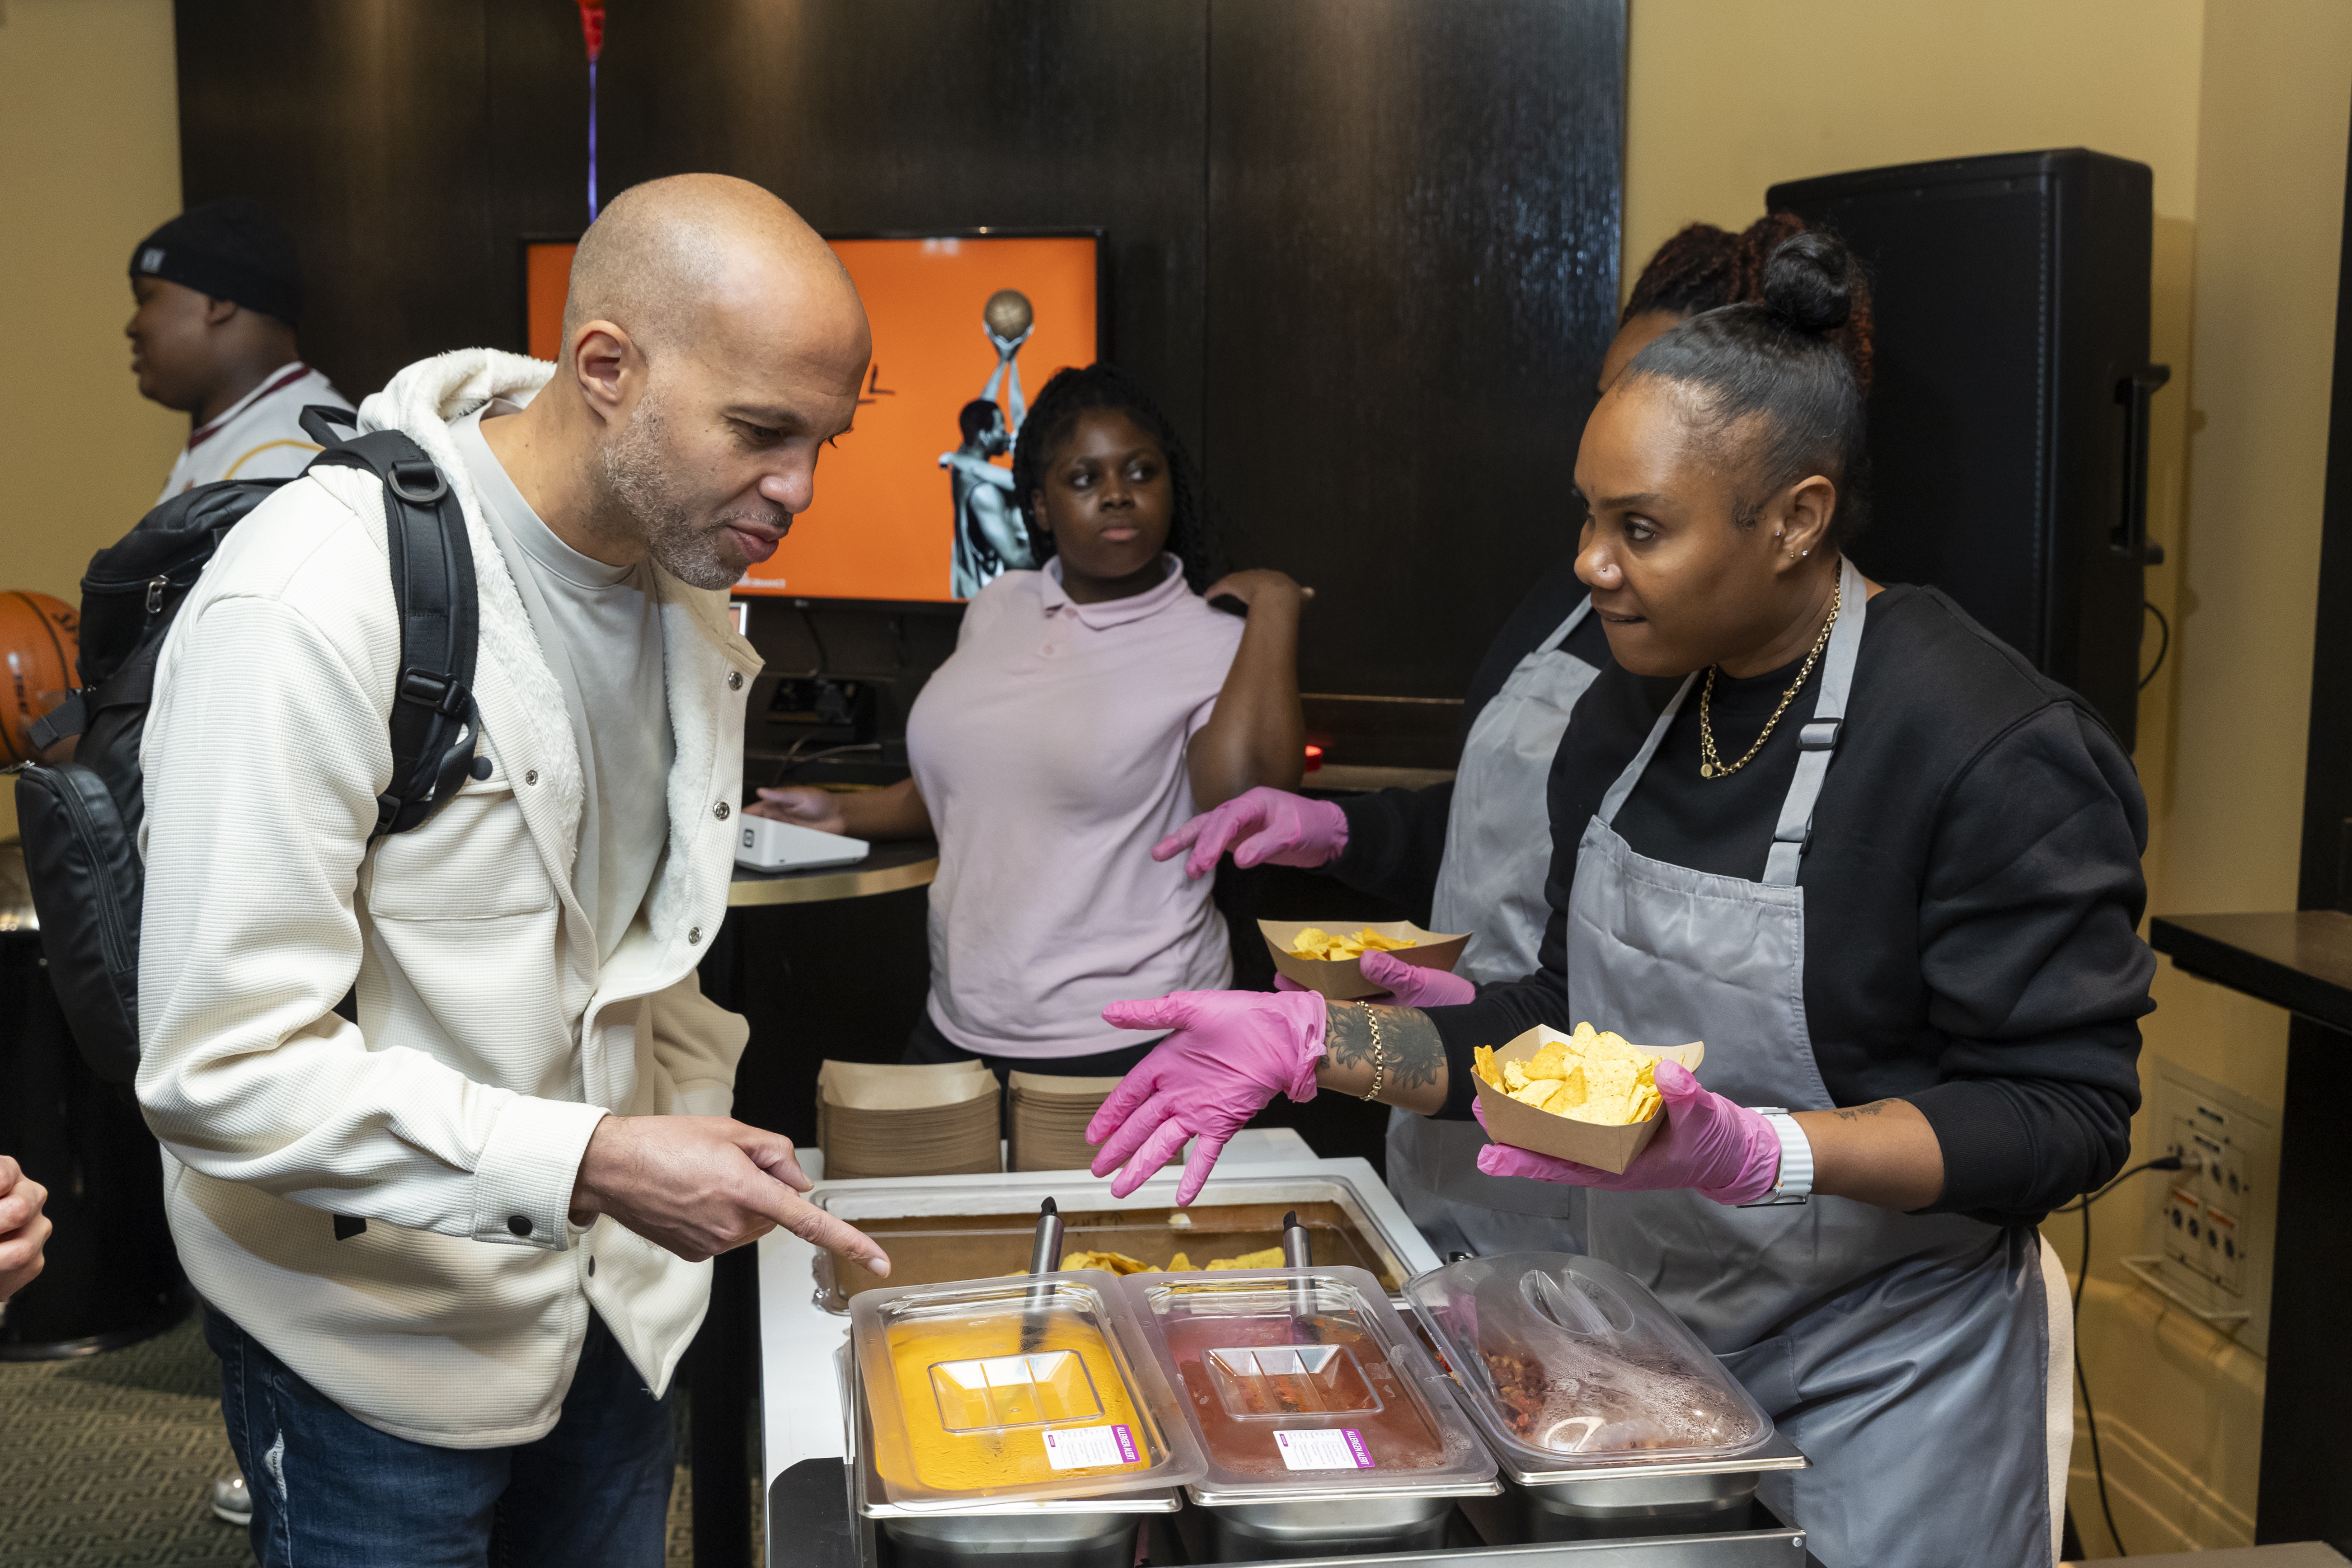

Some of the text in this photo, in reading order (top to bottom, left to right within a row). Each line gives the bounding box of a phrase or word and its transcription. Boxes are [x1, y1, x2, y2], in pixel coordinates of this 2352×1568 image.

[1116, 1427, 1136, 1460] ALLERGEN ALERT
[1346, 1431, 1370, 1465] ALLERGEN ALERT
